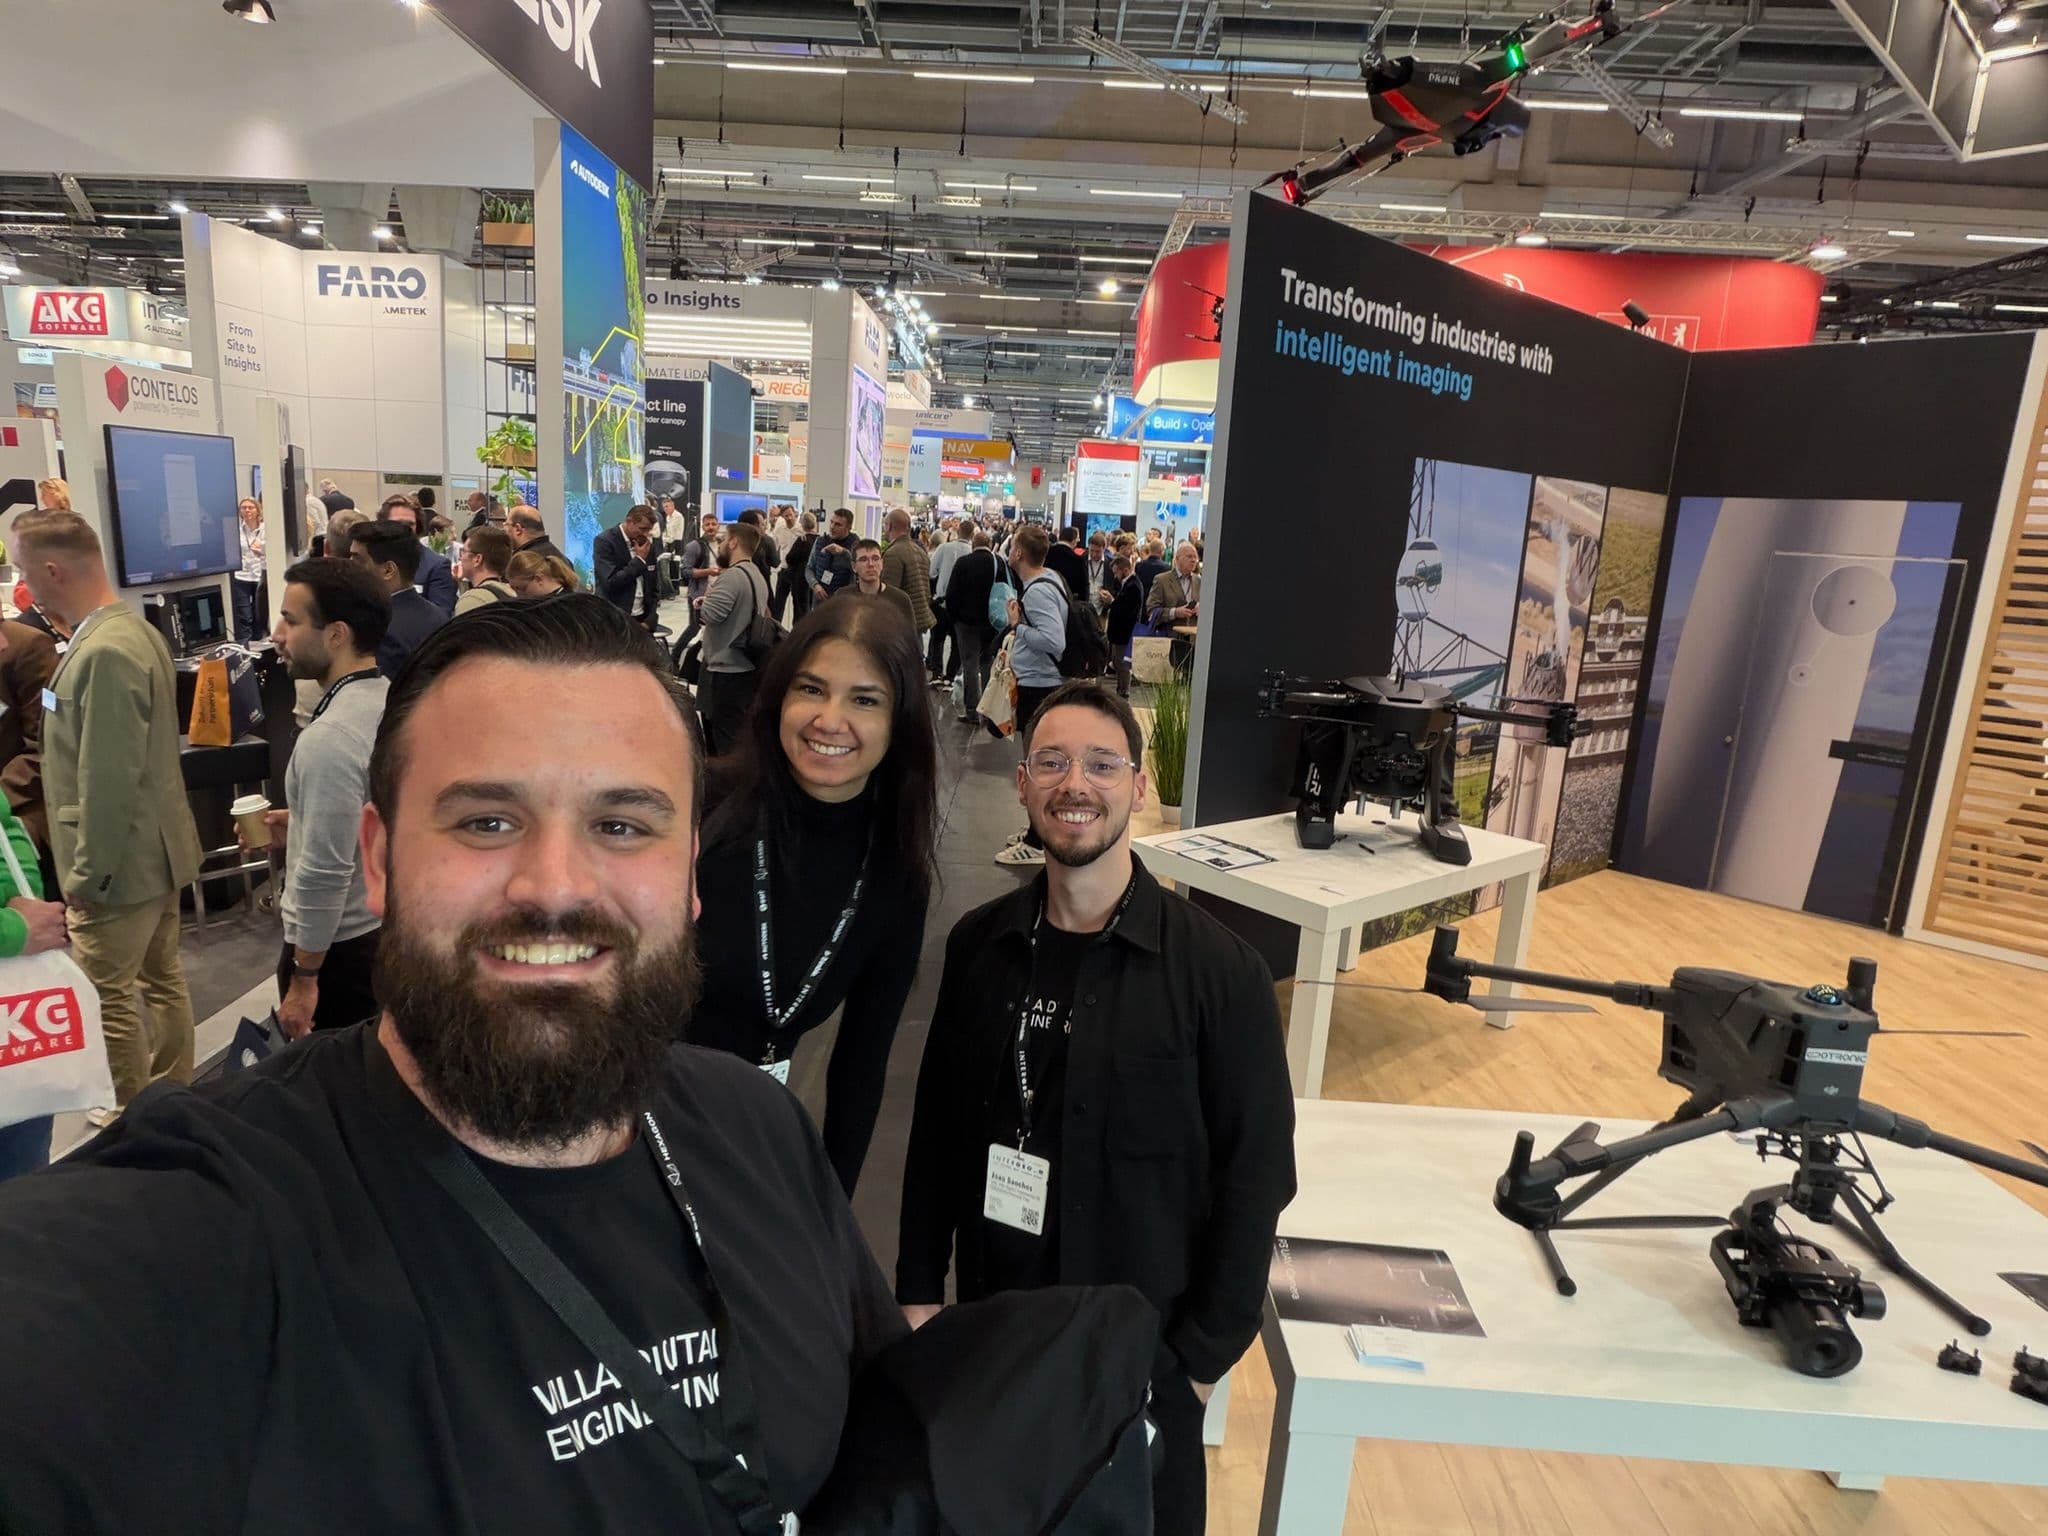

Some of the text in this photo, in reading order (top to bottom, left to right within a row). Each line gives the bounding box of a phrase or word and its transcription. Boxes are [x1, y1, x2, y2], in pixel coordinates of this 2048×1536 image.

[317, 264, 427, 299] FARO
[643, 290, 742, 310] o Insights
[38, 297, 101, 323] AKG
[383, 307, 427, 316] AMETEK
[38, 323, 102, 332] SOFTWARE
[228, 321, 253, 338] From
[1280, 267, 1553, 375] Transforming industries with
[226, 338, 257, 354] Site to
[223, 354, 262, 372] Insights
[1275, 320, 1473, 401] intelligent imaging
[130, 375, 199, 405] CONTELOS
[768, 381, 810, 397] RIEGL
[663, 399, 687, 413] line
[660, 418, 687, 427] canopy
[1153, 416, 1181, 429] Build
[0, 1034, 74, 1061] WARE
[644, 1111, 671, 1161] HEXAGON
